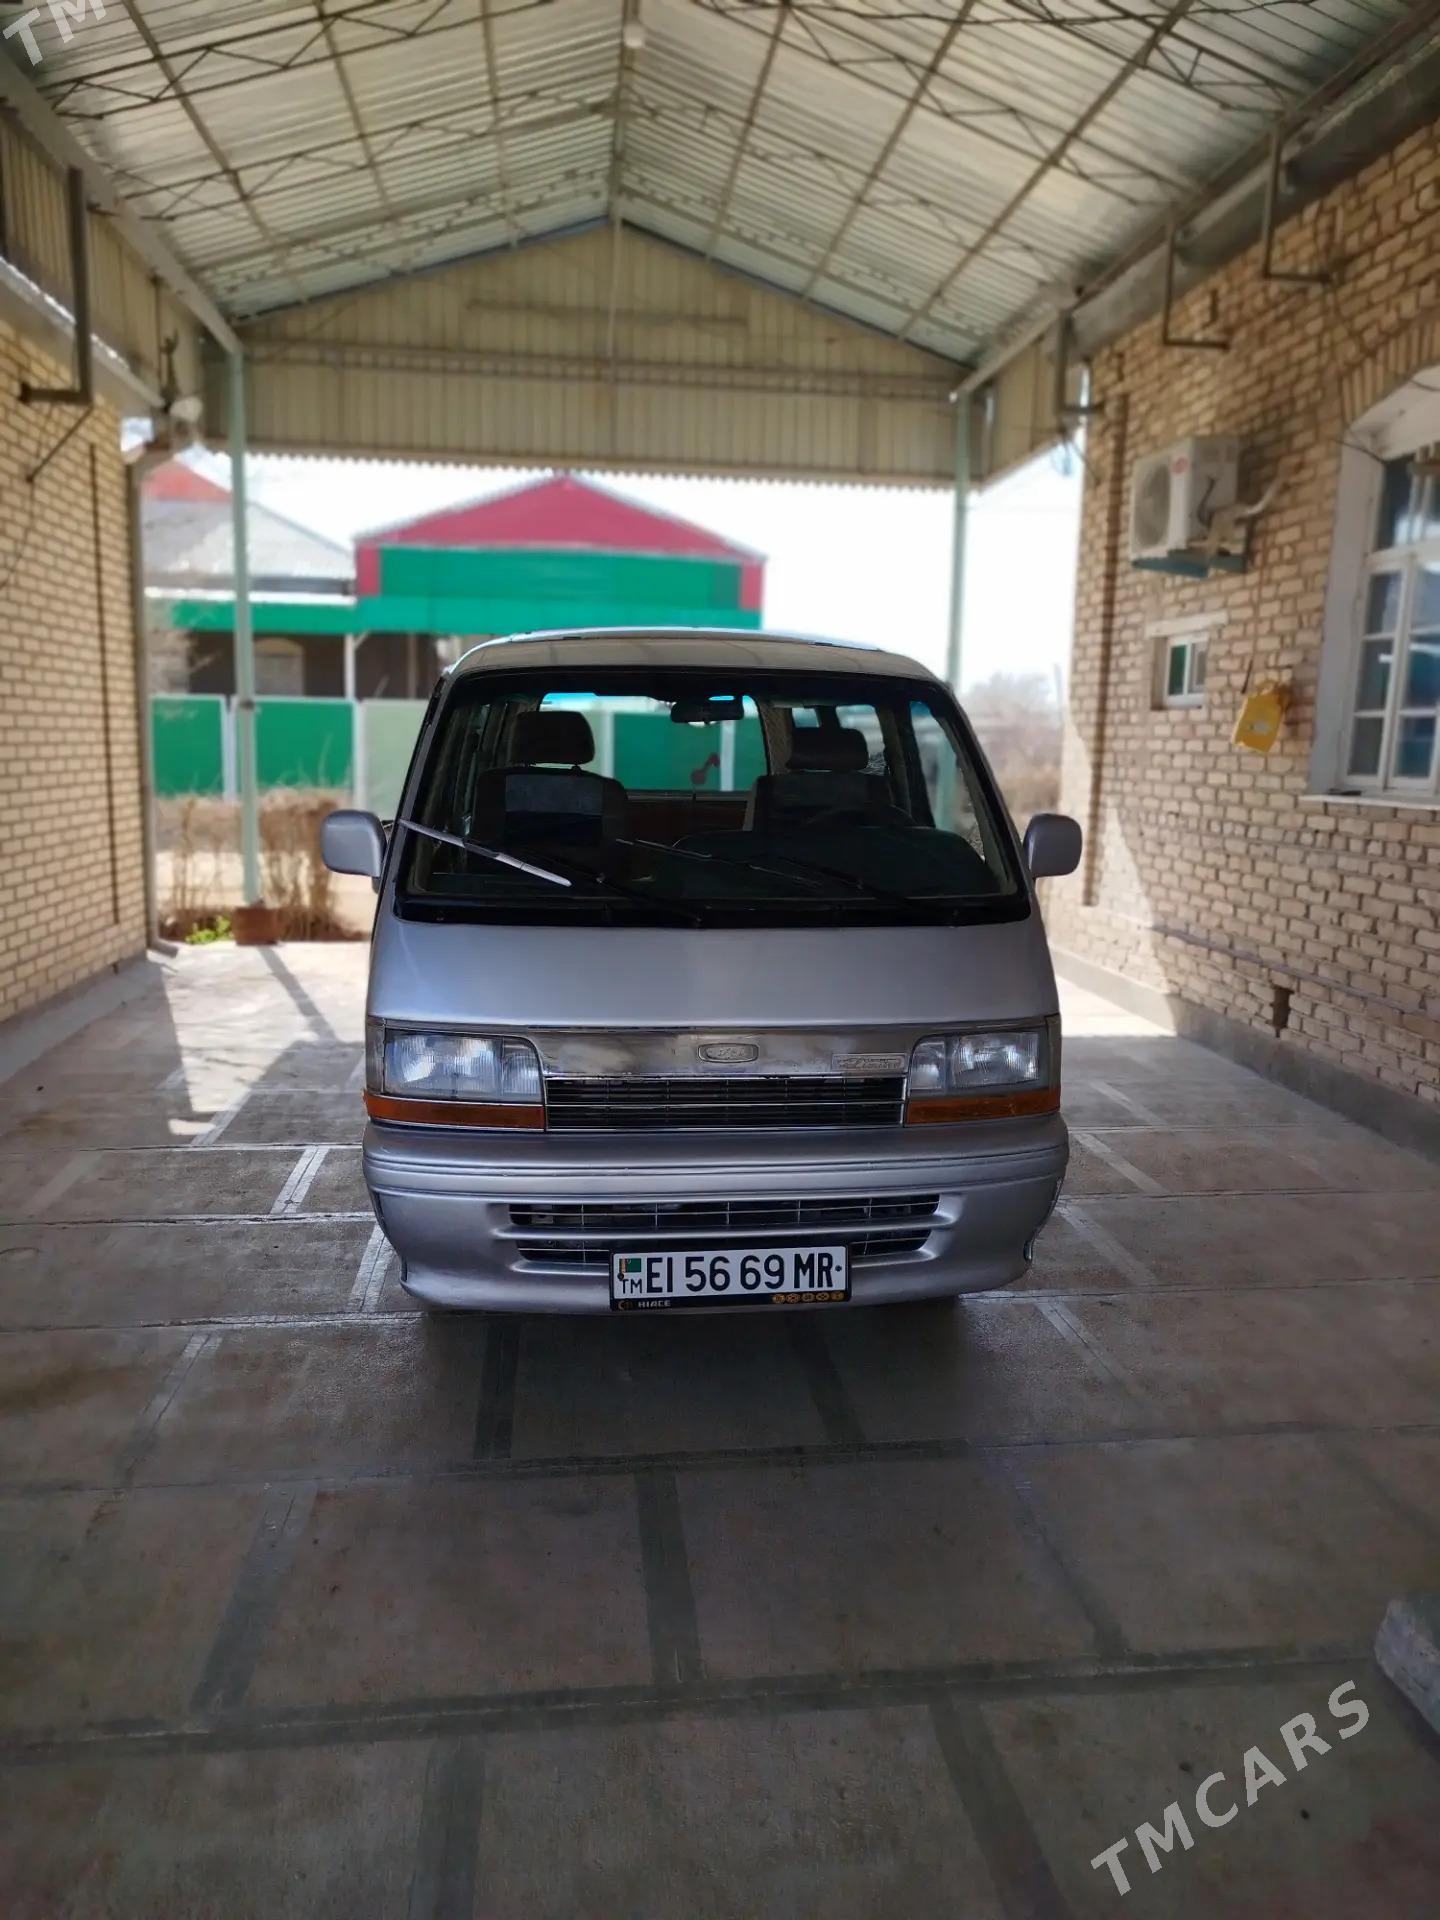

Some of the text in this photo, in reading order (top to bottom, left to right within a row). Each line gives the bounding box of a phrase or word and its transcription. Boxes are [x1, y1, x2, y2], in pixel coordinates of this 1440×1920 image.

[793, 1252, 834, 1289] MR
[621, 1278, 643, 1294] TM
[638, 1300, 671, 1308] HIACE
